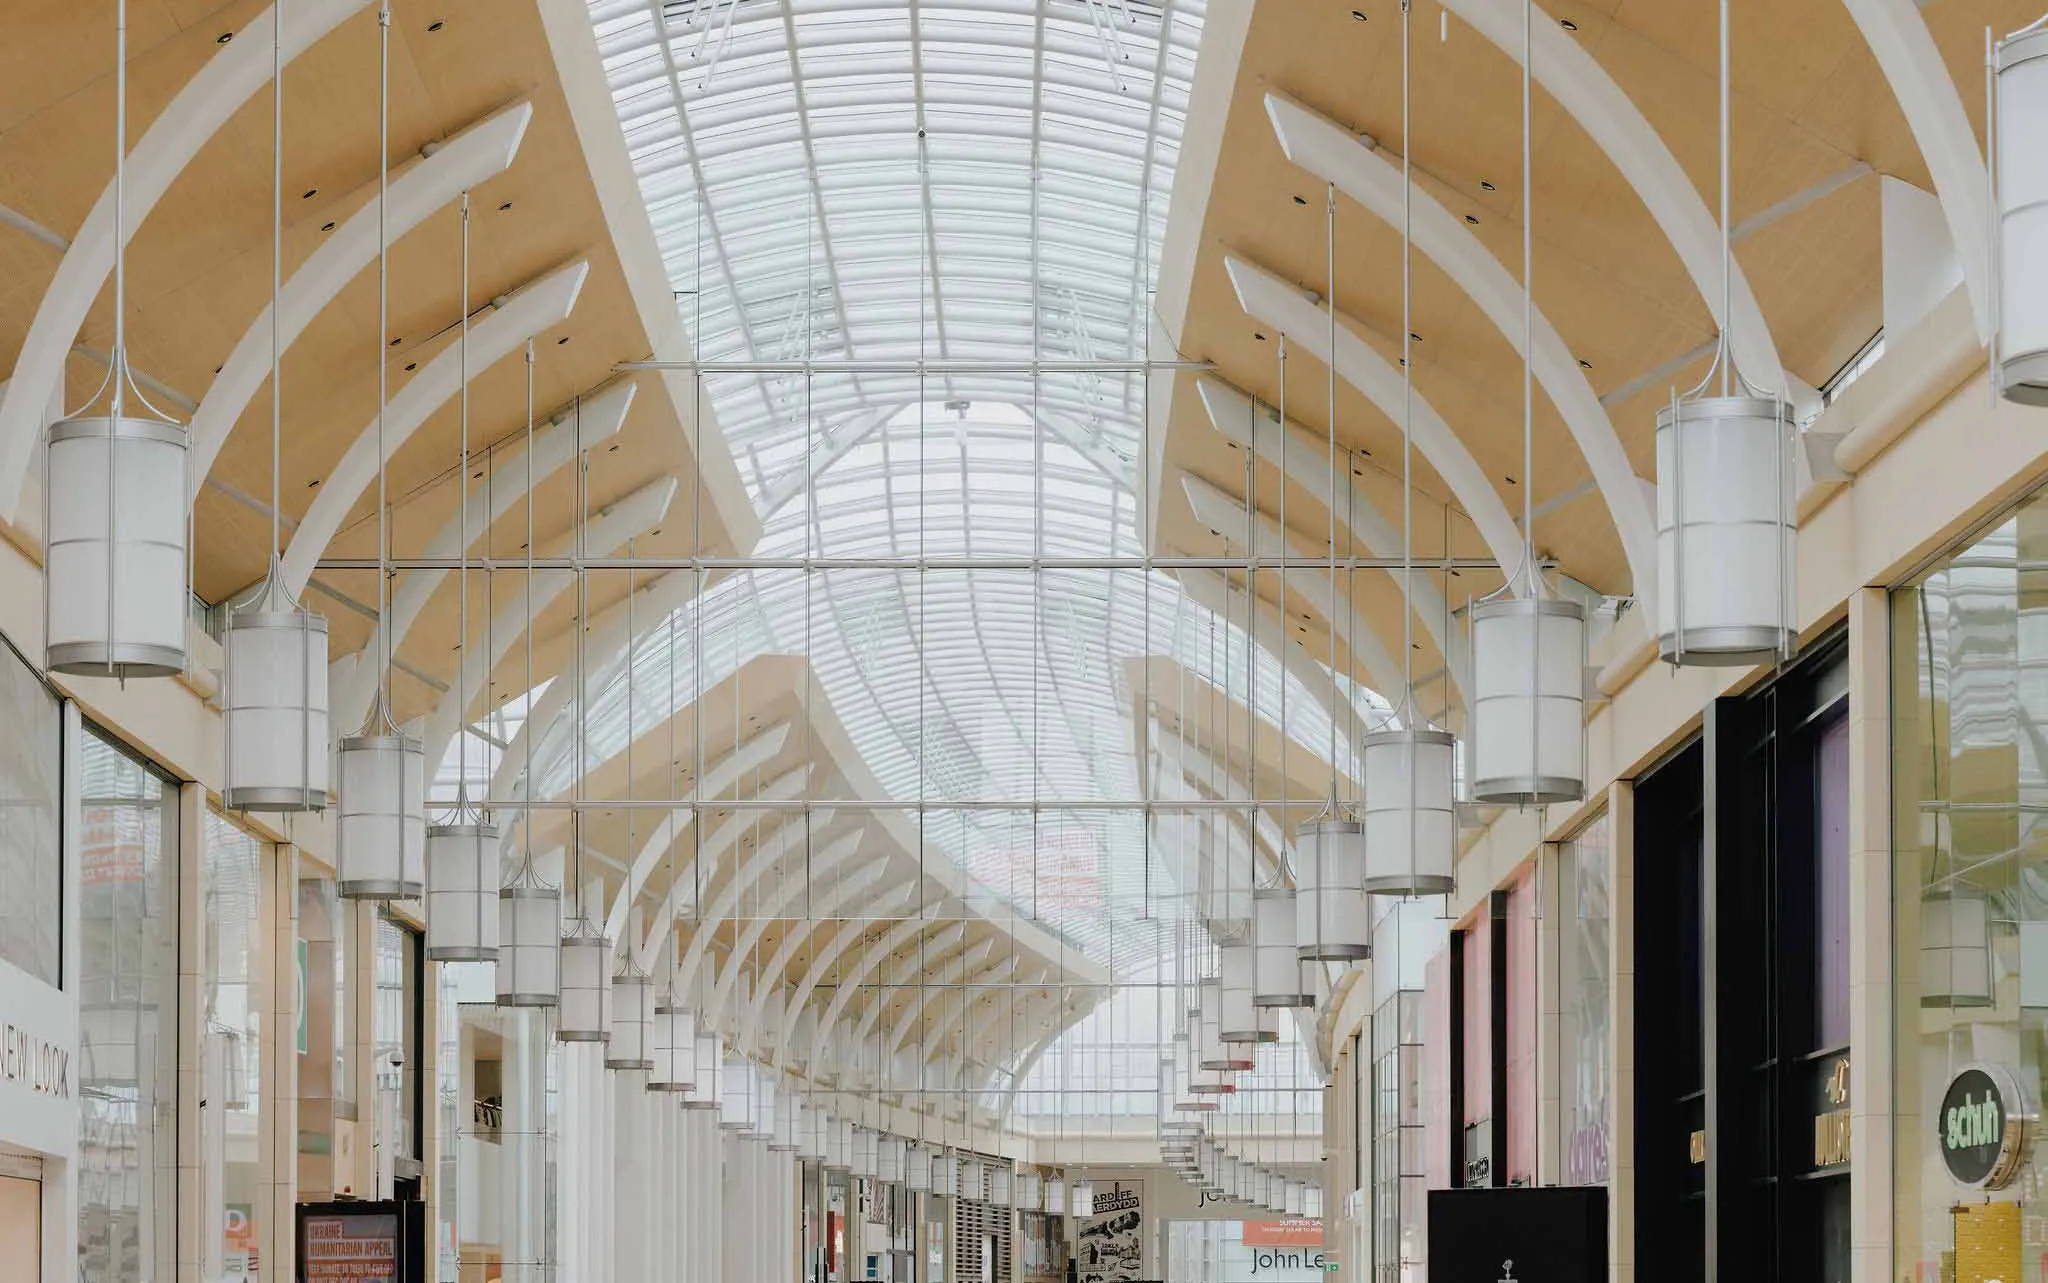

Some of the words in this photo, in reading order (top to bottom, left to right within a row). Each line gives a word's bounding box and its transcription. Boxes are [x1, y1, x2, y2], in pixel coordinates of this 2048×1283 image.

[34, 1038, 69, 1100] LOOK
[1946, 1089, 1998, 1150] schuh
[1093, 1182, 1132, 1202] ARDIFF
[1094, 1198, 1138, 1213] ERDYDD
[309, 1222, 341, 1239] UKRAINE
[309, 1240, 363, 1257] HUMANITARIAN
[365, 1239, 393, 1257] APPEAL
[1251, 1247, 1299, 1274] John
